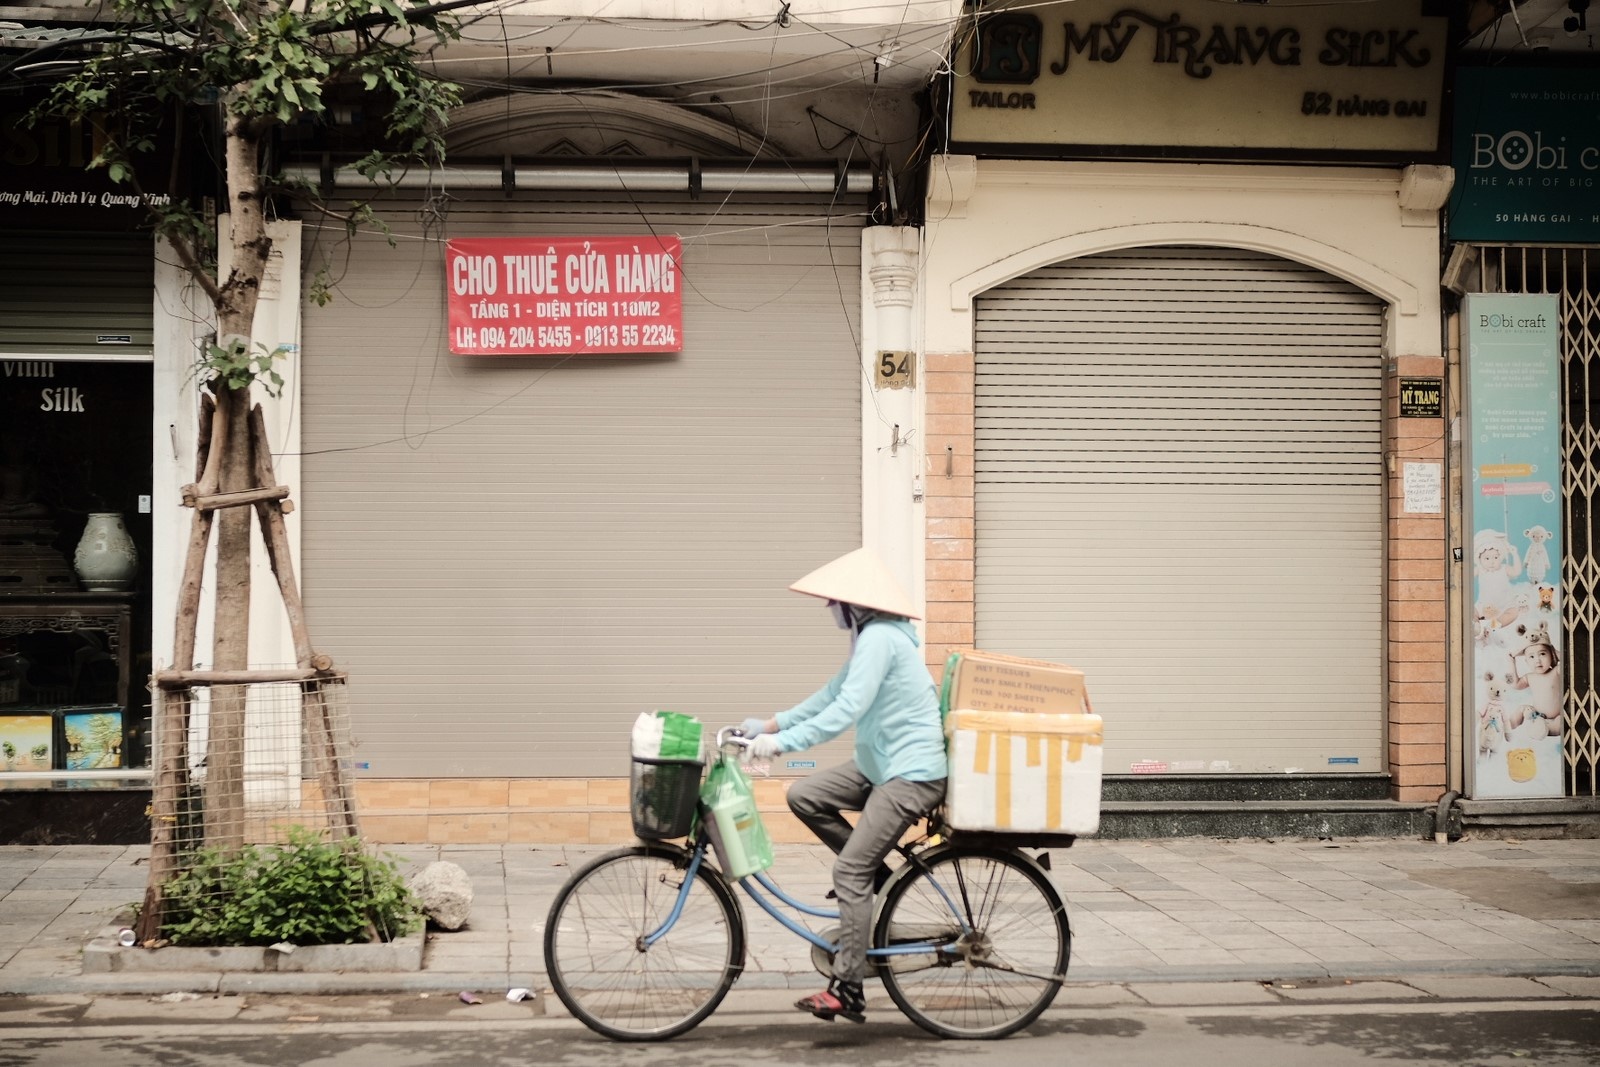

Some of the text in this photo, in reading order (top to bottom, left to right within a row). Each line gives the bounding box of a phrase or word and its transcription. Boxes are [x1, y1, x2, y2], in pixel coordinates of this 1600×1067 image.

[1111, 9, 1300, 79] TRANG
[970, 91, 1036, 109] TAILOR
[1301, 92, 1427, 117] 52 HÀNG GAI
[1473, 177, 1593, 187] THE ART OF BIG
[51, 191, 78, 206] Dịch
[80, 192, 97, 206] Vụ
[101, 192, 140, 208] Quang
[1496, 214, 1509, 222] 50
[1514, 212, 1546, 222] HÀNG
[1551, 214, 1571, 222] GAI
[453, 241, 675, 296] CHO THUÊ CỬA HÀNG
[470, 298, 509, 319] TẦNG
[513, 303, 521, 318] 1
[536, 299, 571, 320] DIỆN
[575, 299, 608, 317] TÍCH
[612, 301, 660, 317] 110M2
[1518, 314, 1546, 328] craft
[456, 326, 477, 348] LH:
[480, 327, 506, 348] 094
[510, 327, 535, 348] 204
[538, 326, 572, 347] 5455
[585, 325, 618, 347] 0913
[622, 325, 639, 346] 55
[642, 324, 675, 346] 2234
[881, 354, 910, 378] 54
[40, 387, 85, 412] Silk
[1414, 390, 1439, 405] TRANG
[976, 664, 1031, 677] WET TISSUES
[974, 676, 995, 685] BABY
[998, 680, 1022, 688] SMILE
[998, 691, 1012, 699] 100
[1014, 693, 1045, 704] SHEETS
